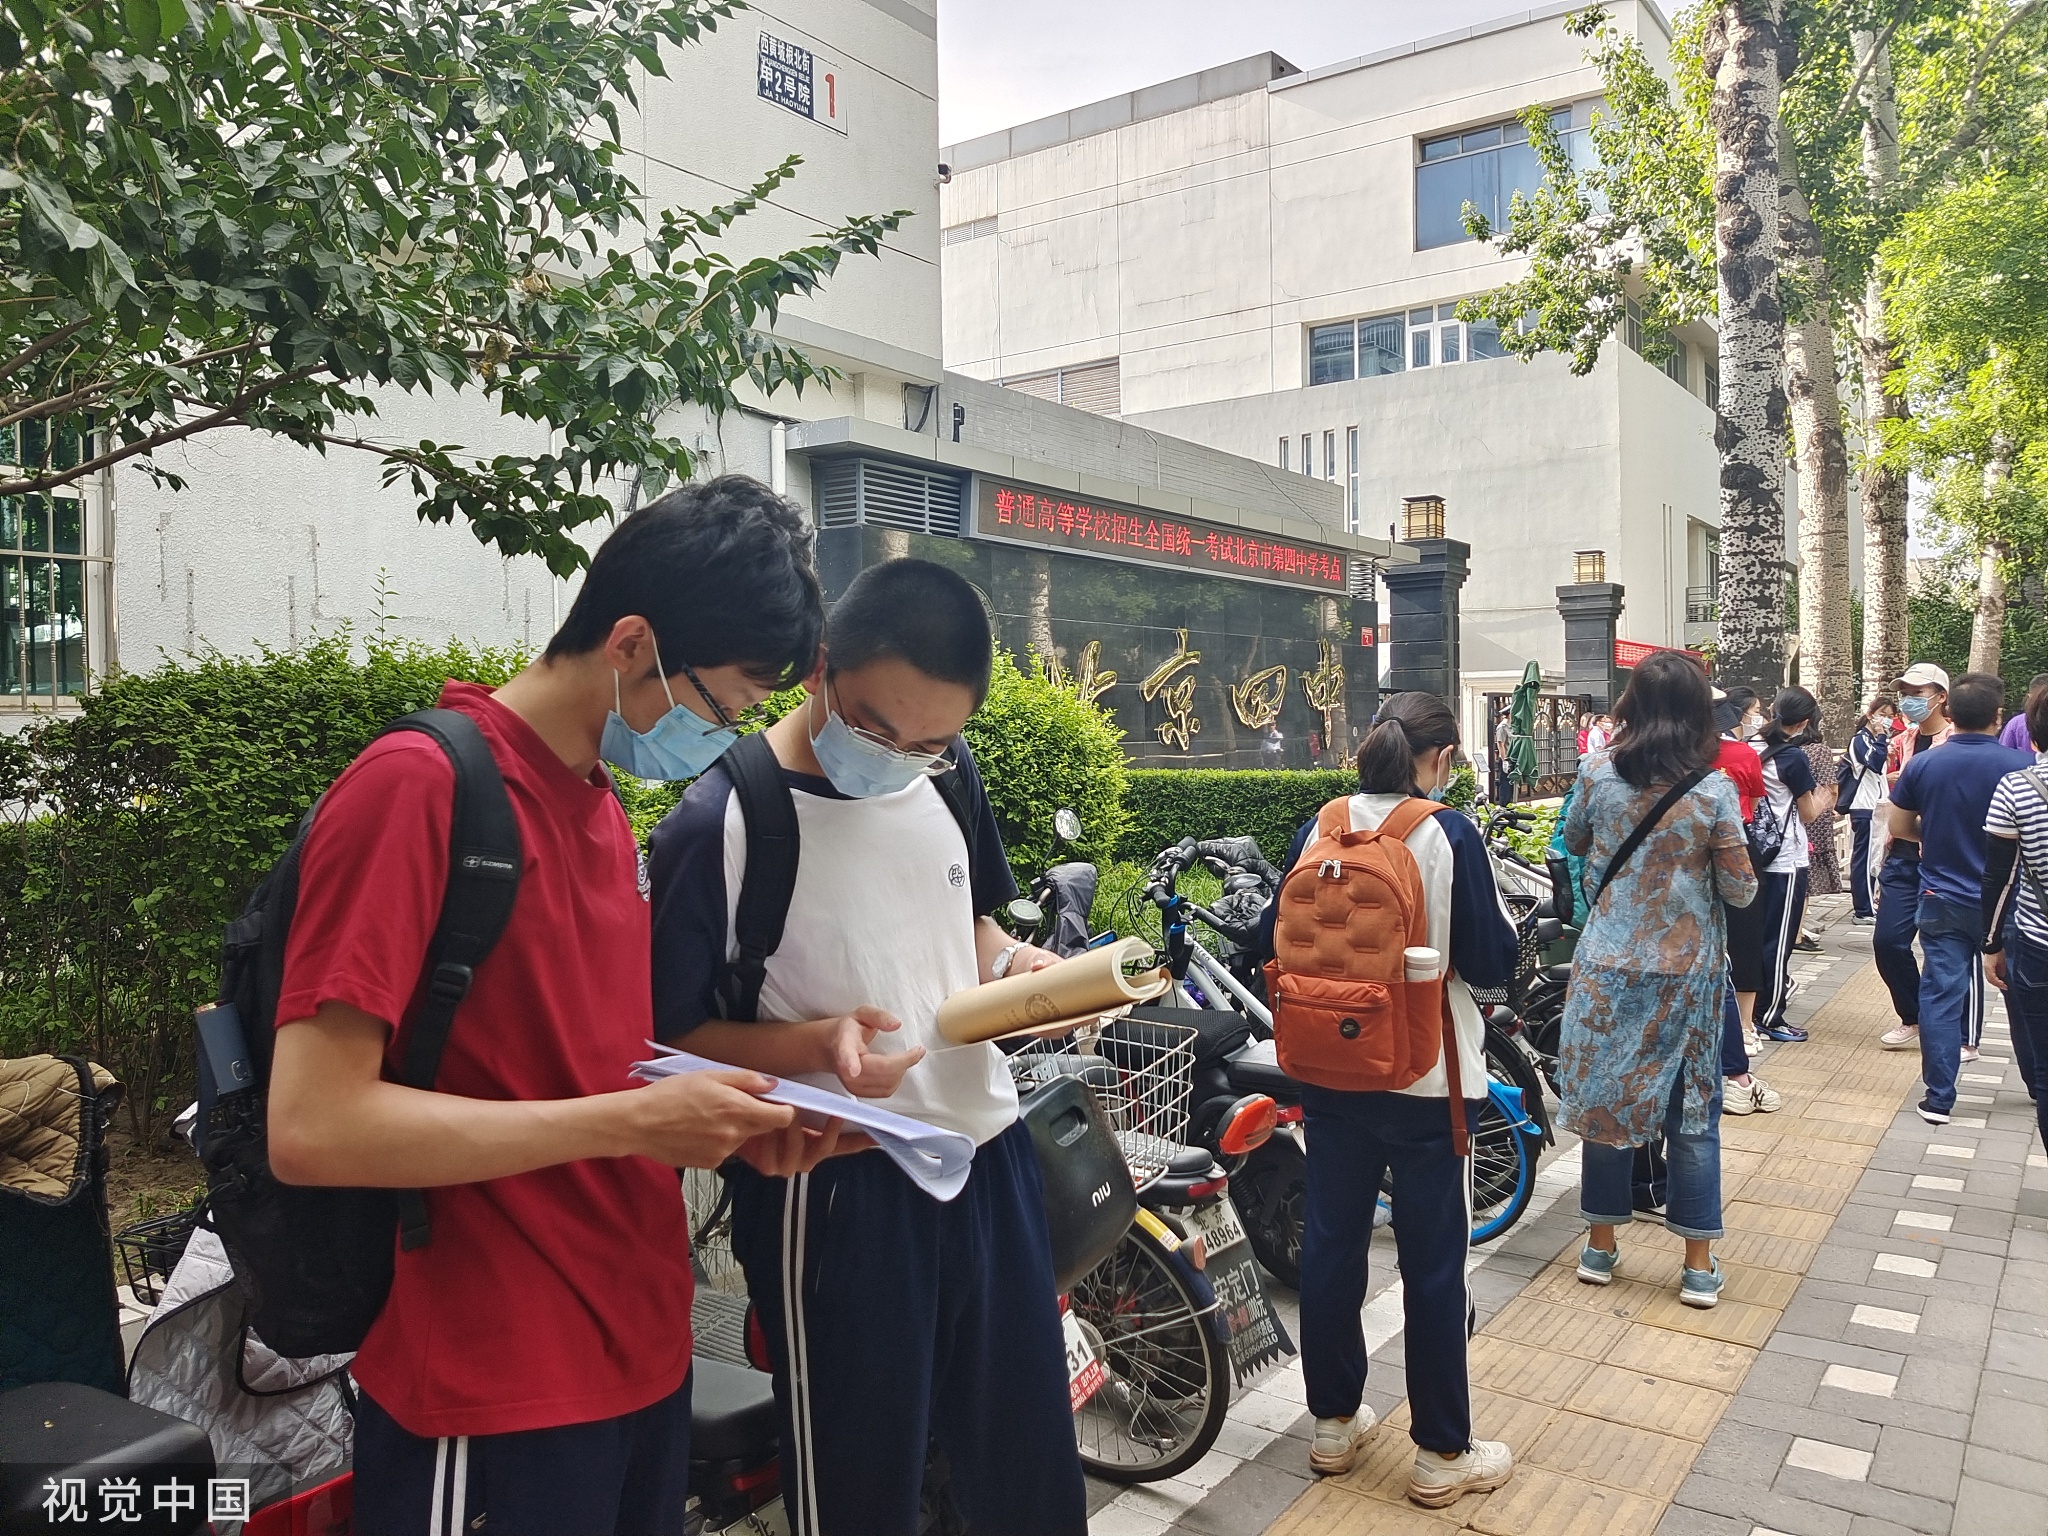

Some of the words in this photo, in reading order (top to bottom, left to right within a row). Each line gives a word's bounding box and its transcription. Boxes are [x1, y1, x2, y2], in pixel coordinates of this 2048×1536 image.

[825, 73, 835, 119] 1
[994, 488, 1342, 582] 普通高等学校招生全国统一考试北京市第四中学考点
[1204, 1220, 1242, 1253] 48964
[1213, 1259, 1259, 1311] 安定门
